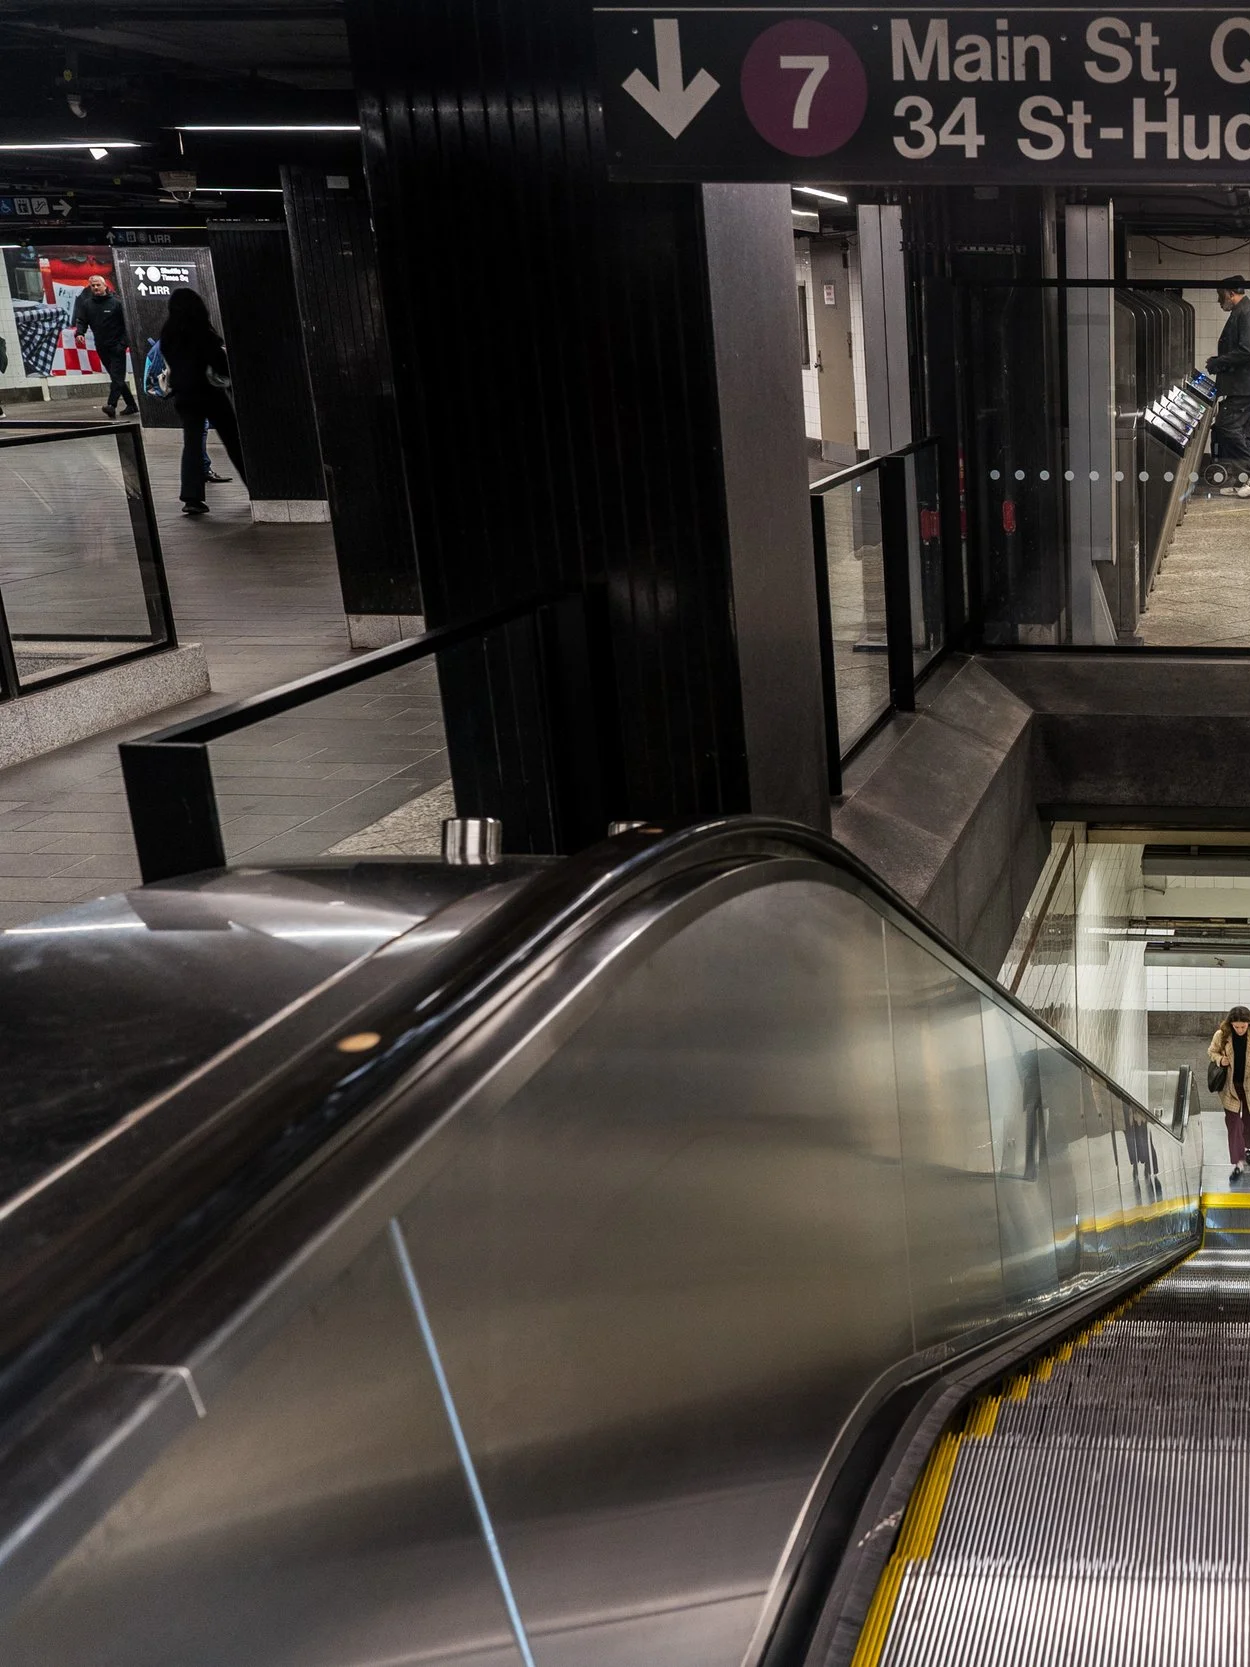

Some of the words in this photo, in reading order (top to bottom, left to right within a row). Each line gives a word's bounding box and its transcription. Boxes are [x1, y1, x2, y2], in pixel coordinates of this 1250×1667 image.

[891, 18, 1051, 82] Main
[1085, 18, 1177, 95] St,
[779, 55, 830, 129] 7
[893, 96, 986, 159] 34
[148, 234, 171, 243] LIRR
[148, 285, 170, 295] LIRR
[161, 274, 180, 282] Times
[179, 274, 189, 283] Sq
